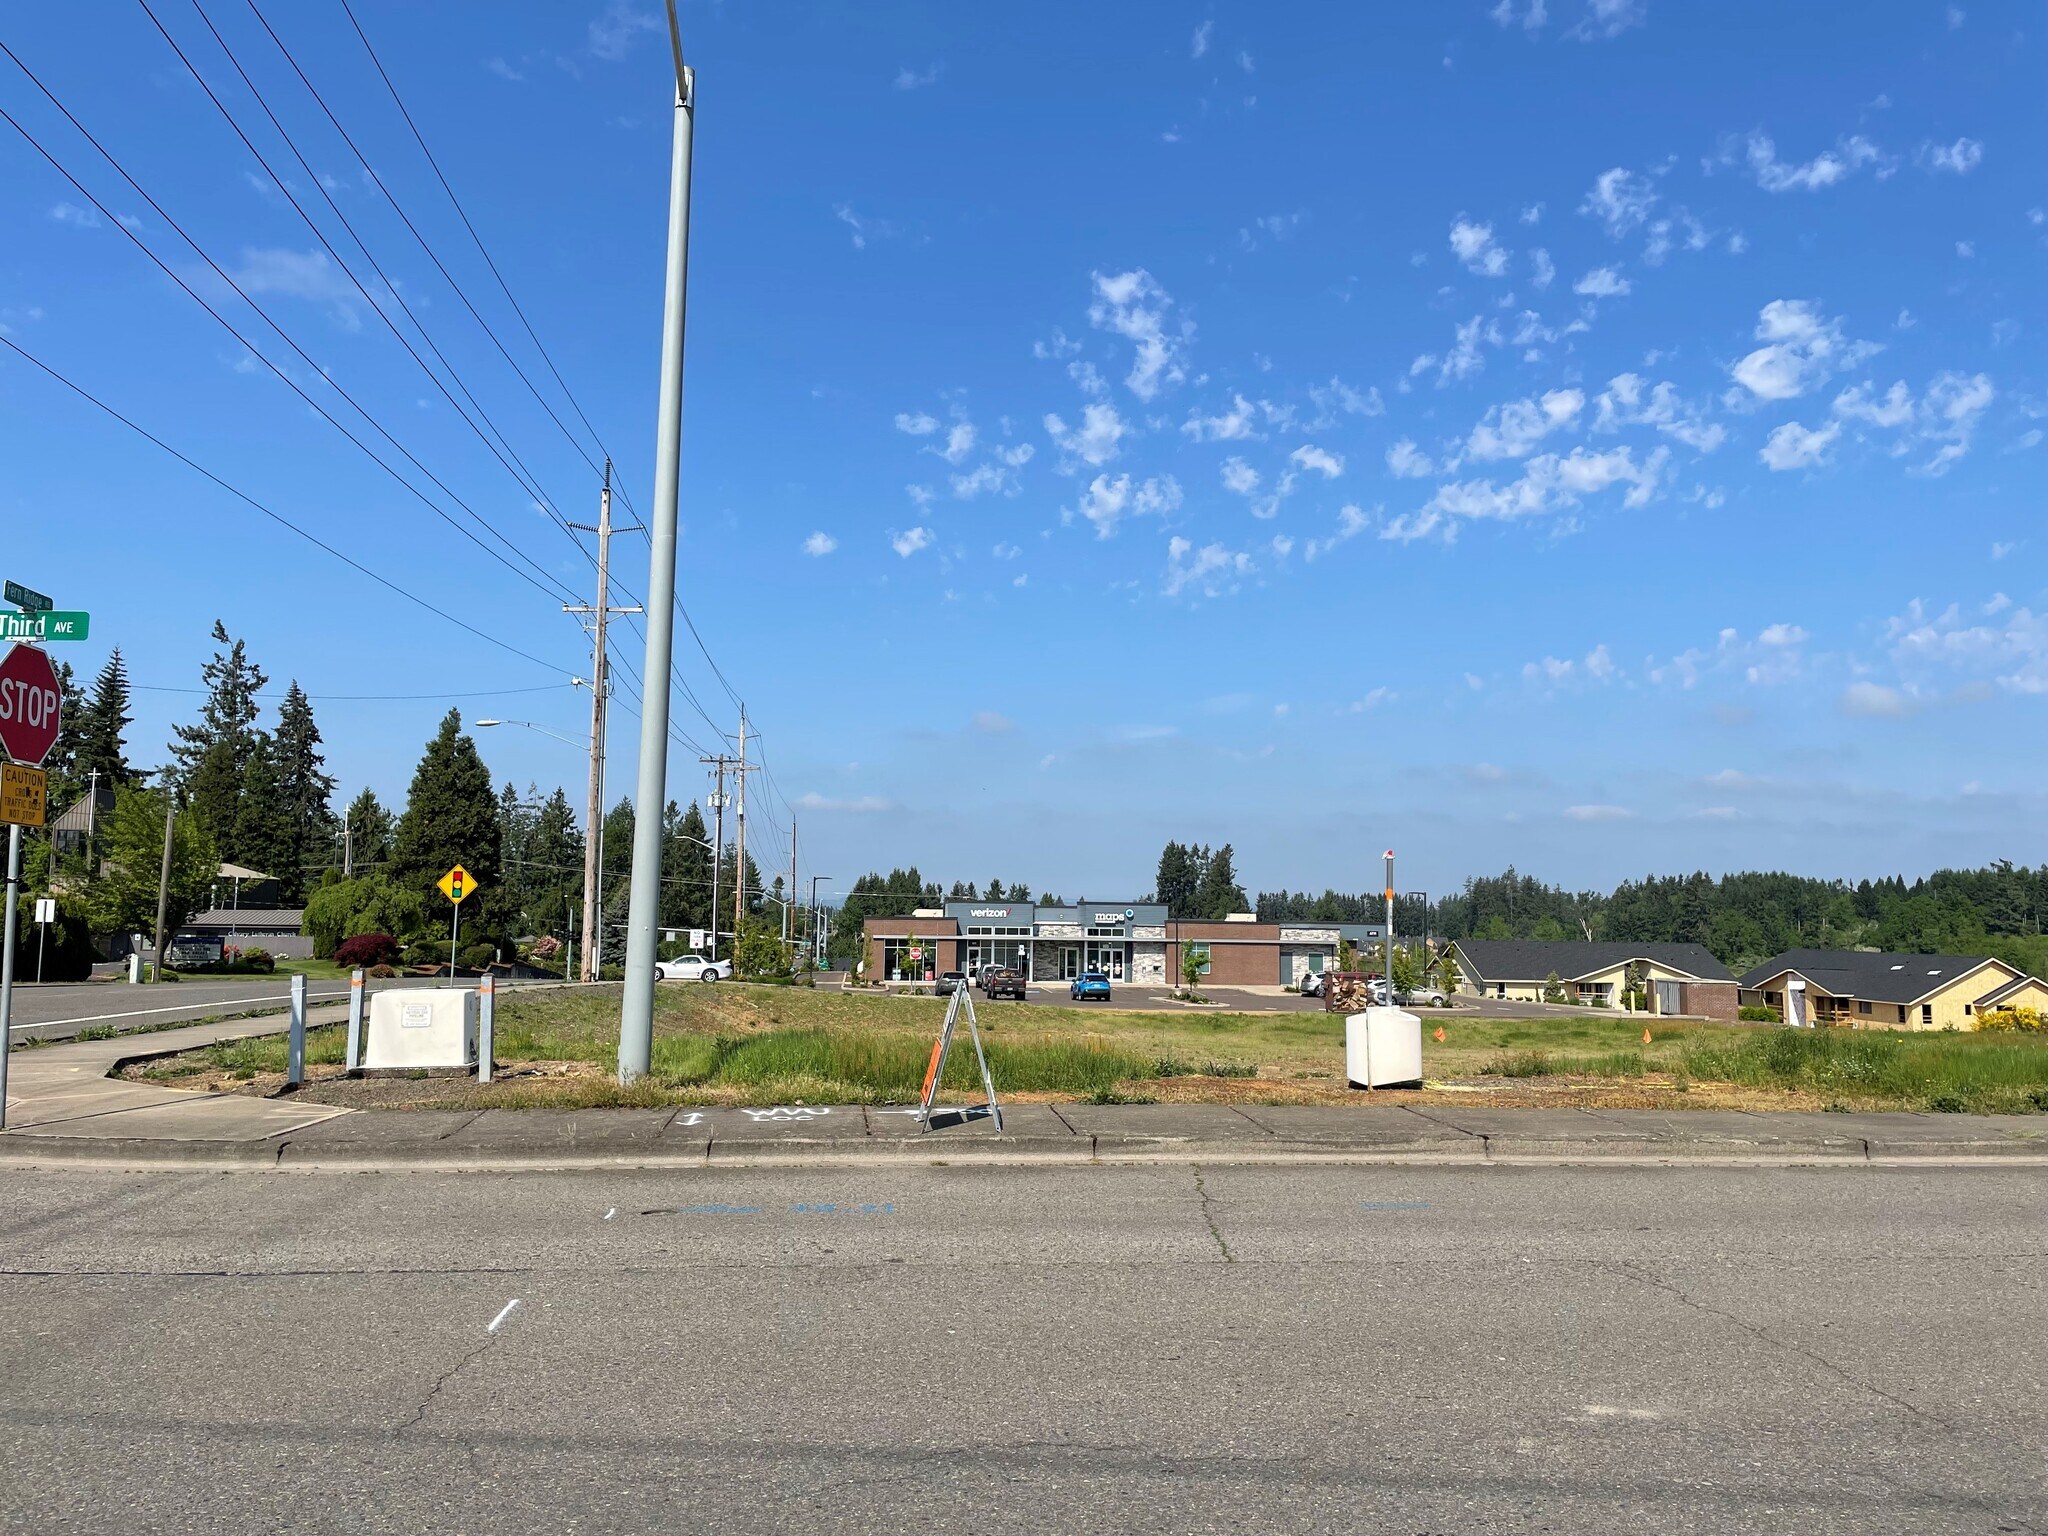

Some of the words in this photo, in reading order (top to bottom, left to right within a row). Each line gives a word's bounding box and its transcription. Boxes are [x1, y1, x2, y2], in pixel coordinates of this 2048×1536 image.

[6, 582, 22, 600] Fern
[24, 589, 43, 609] Ridge
[0, 615, 46, 636] Third
[54, 622, 74, 633] AVE
[0, 677, 57, 730] STOP
[5, 769, 43, 787] CAUTION
[15, 788, 33, 798] CROS
[5, 797, 26, 808] TRAFFIC
[9, 809, 20, 818] NOT
[22, 811, 36, 820] STOP
[970, 908, 1007, 917] verizon
[1095, 912, 1125, 922] maps
